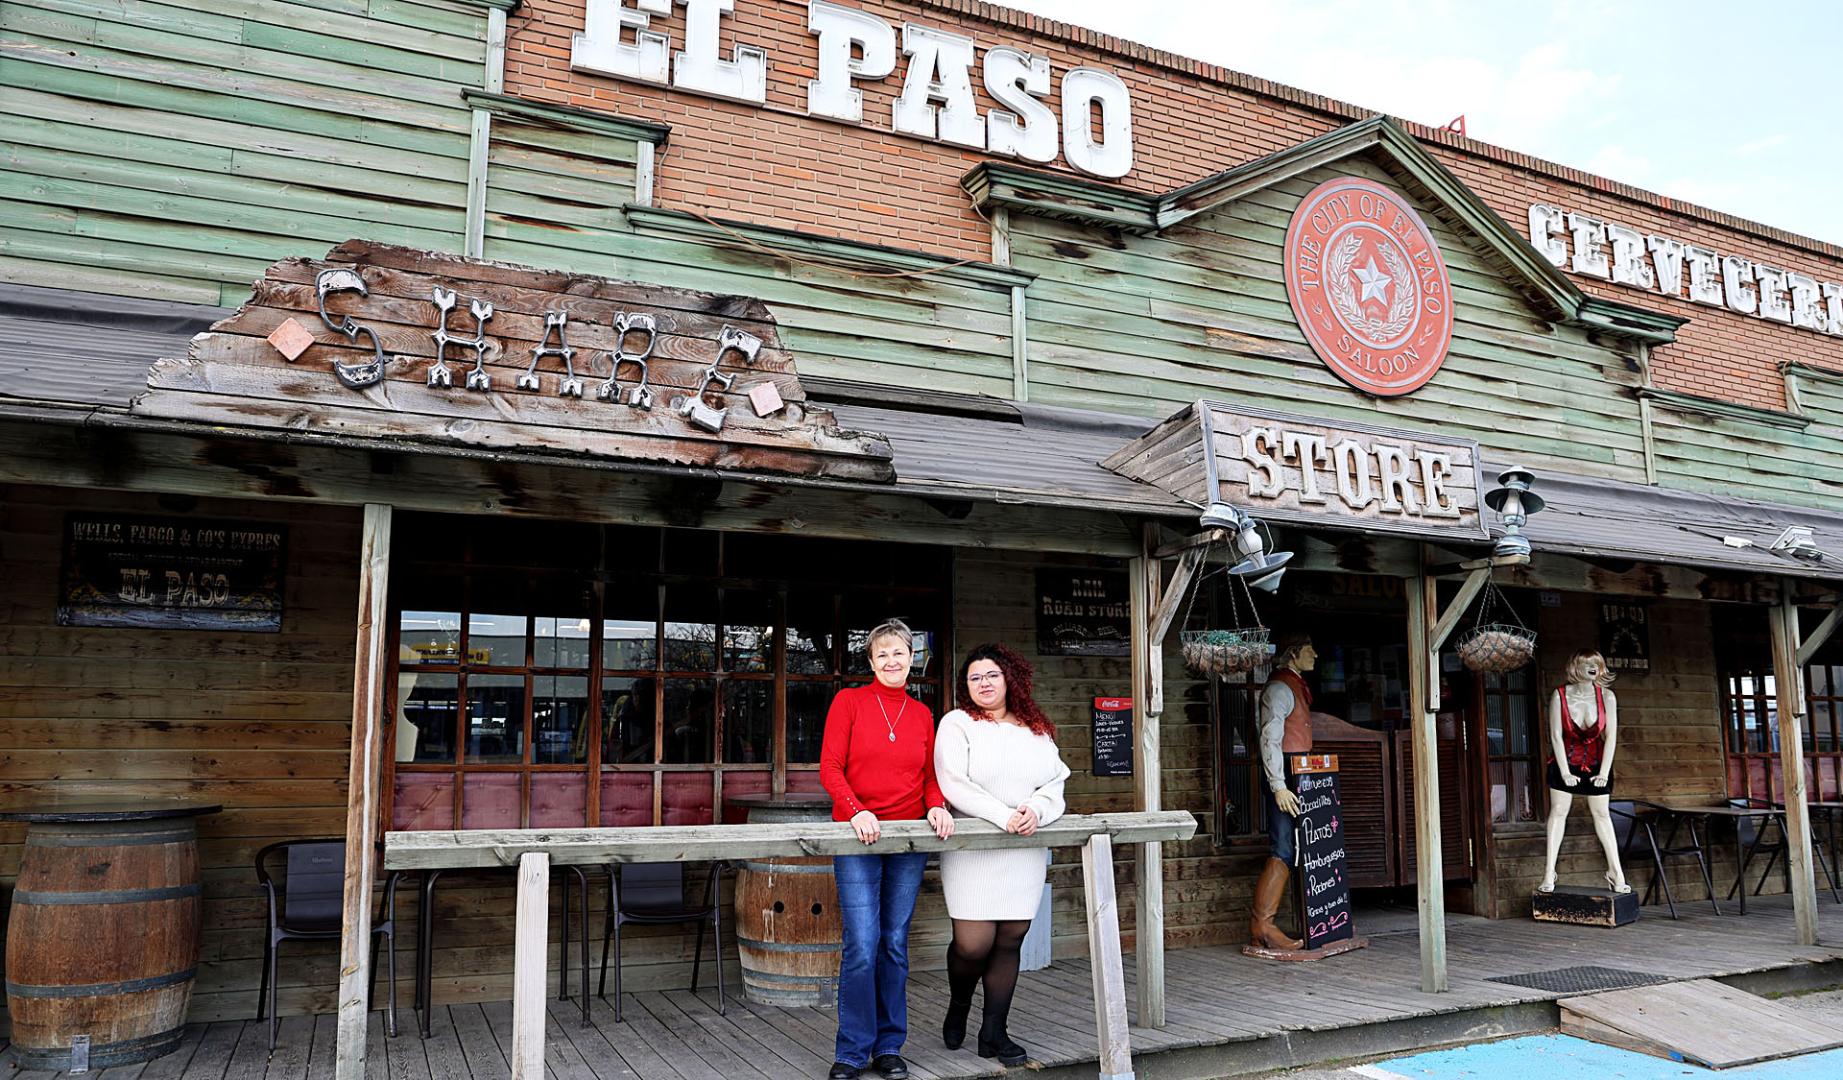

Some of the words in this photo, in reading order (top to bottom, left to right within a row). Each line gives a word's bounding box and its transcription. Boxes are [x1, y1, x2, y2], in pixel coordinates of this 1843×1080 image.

[571, 0, 767, 105] EL
[807, 0, 1134, 179] PASO
[1300, 235, 1321, 293] THE
[1312, 194, 1353, 235] CITY
[1360, 194, 1387, 221] OF
[1390, 214, 1413, 248] EL
[1413, 249, 1442, 314] PASO
[1337, 334, 1420, 375] SALOON
[1240, 425, 1461, 519] STORE
[179, 529, 191, 547] &
[118, 568, 155, 604] EL
[163, 570, 230, 608] PASO
